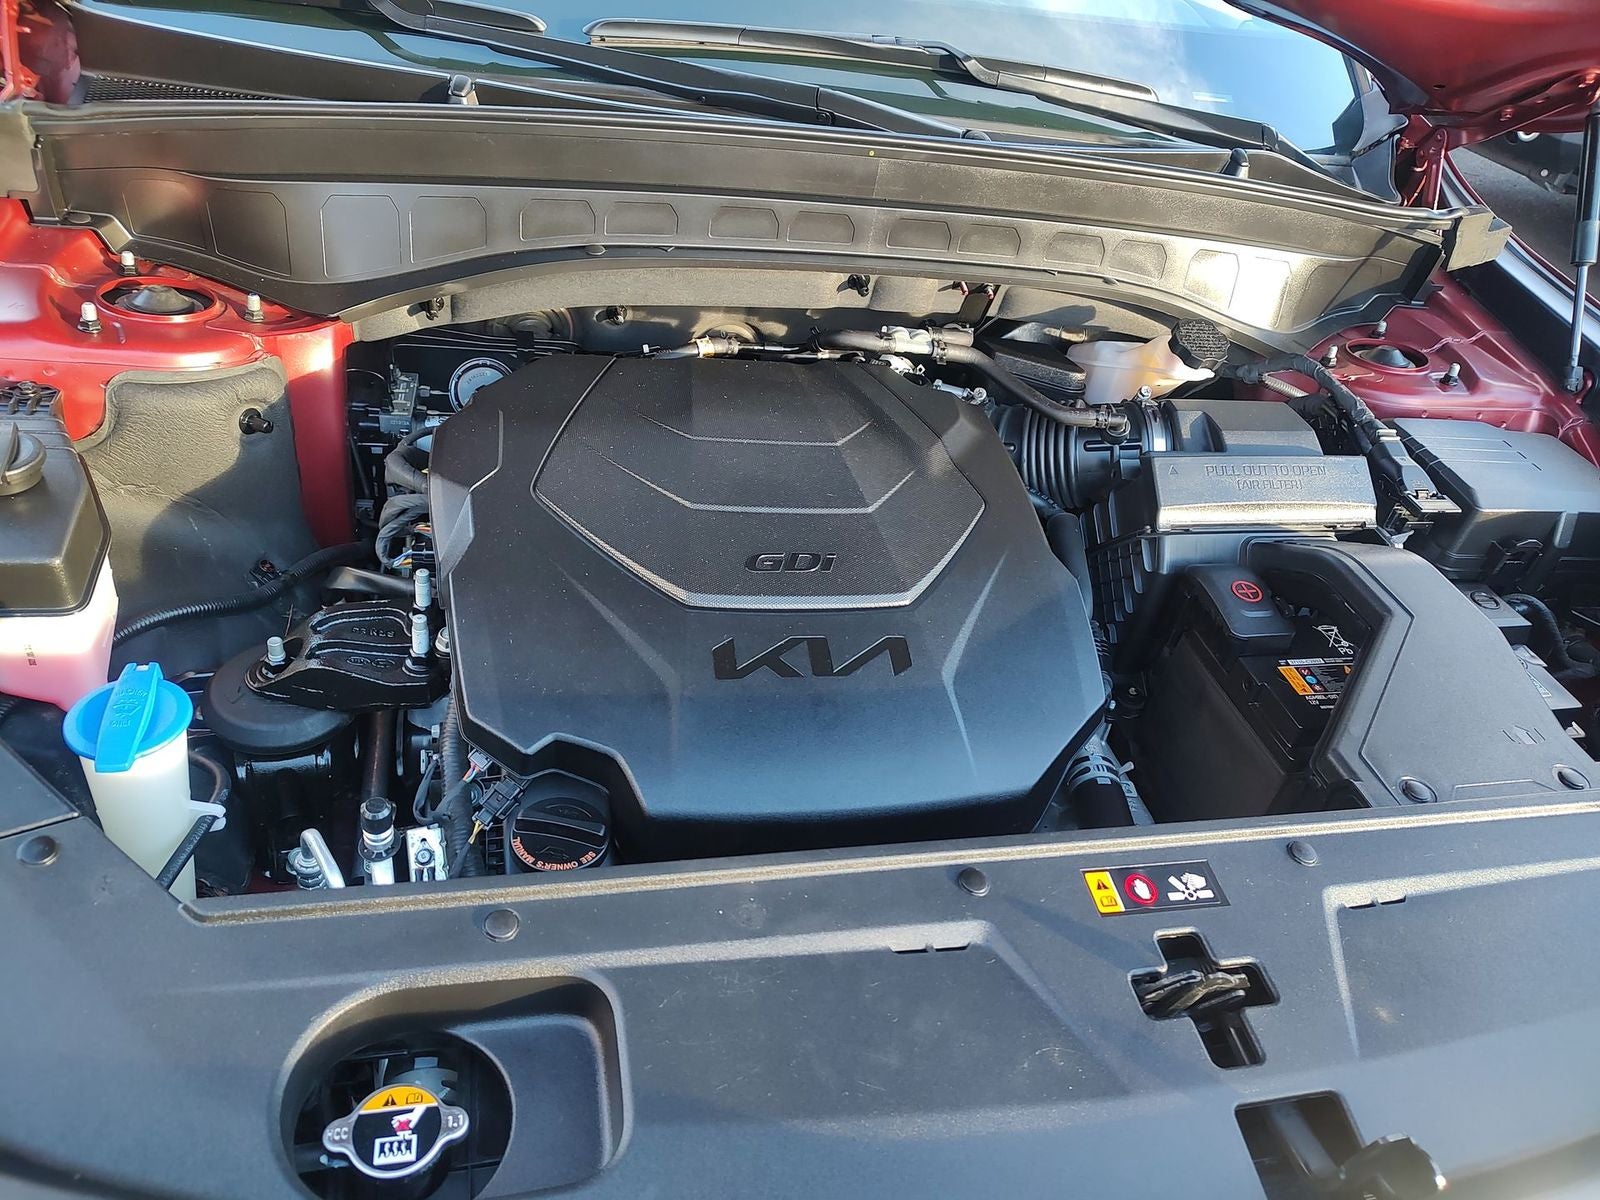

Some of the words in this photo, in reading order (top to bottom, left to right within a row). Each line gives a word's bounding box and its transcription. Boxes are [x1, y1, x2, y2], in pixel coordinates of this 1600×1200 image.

[1204, 464, 1240, 477] PULL
[1242, 464, 1269, 476] OUT
[1272, 463, 1290, 476] TO
[1292, 463, 1327, 476] OPEN
[745, 552, 837, 573] GDi
[712, 635, 912, 680] KIA
[512, 836, 535, 863] MANUAL
[579, 851, 597, 864] SEE
[536, 860, 579, 870] OWNER'S
[327, 1127, 349, 1141] HCC
[447, 1114, 464, 1128] 1.1
